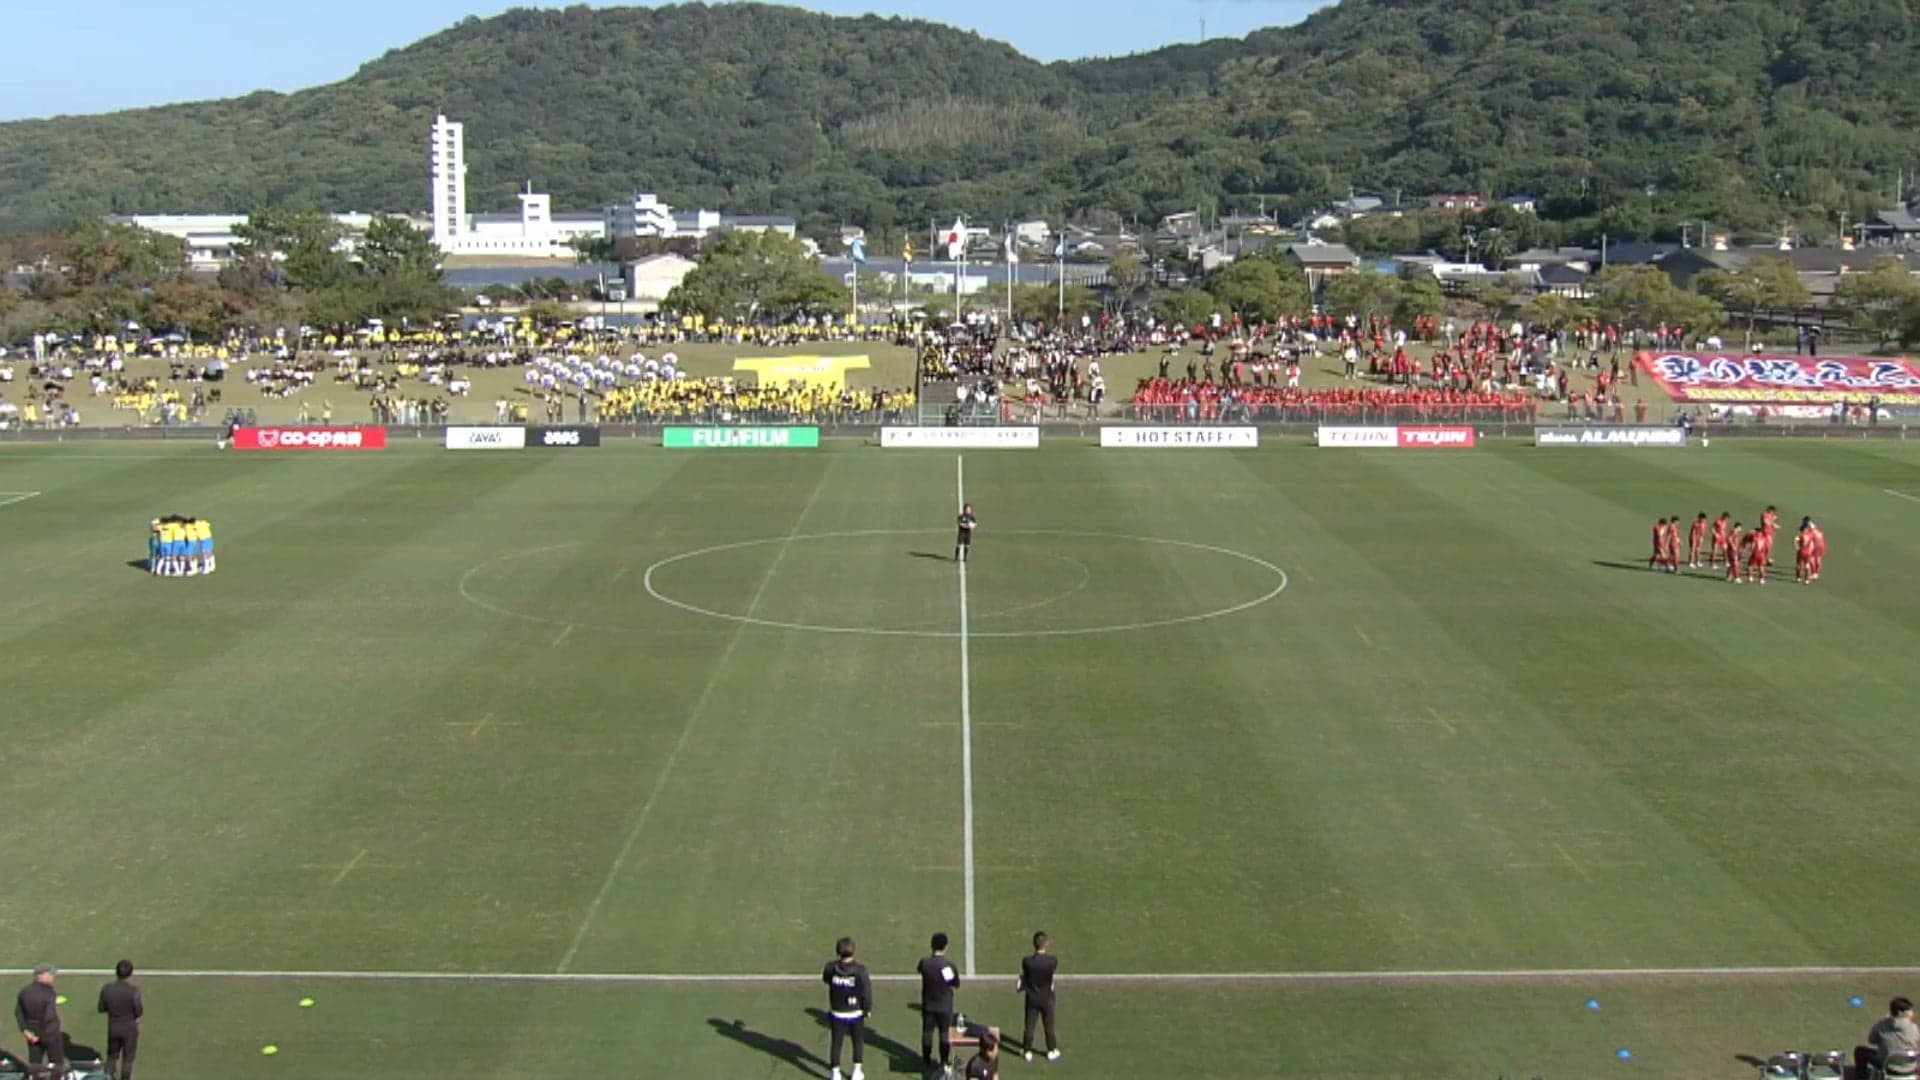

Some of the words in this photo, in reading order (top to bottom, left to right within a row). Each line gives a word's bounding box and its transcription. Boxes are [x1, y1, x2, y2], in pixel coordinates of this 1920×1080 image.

[692, 428, 790, 447] FUJIFILM
[1135, 432, 1170, 444] HOT
[1173, 432, 1223, 444] STAFF
[1402, 431, 1467, 444] TEIJIN
